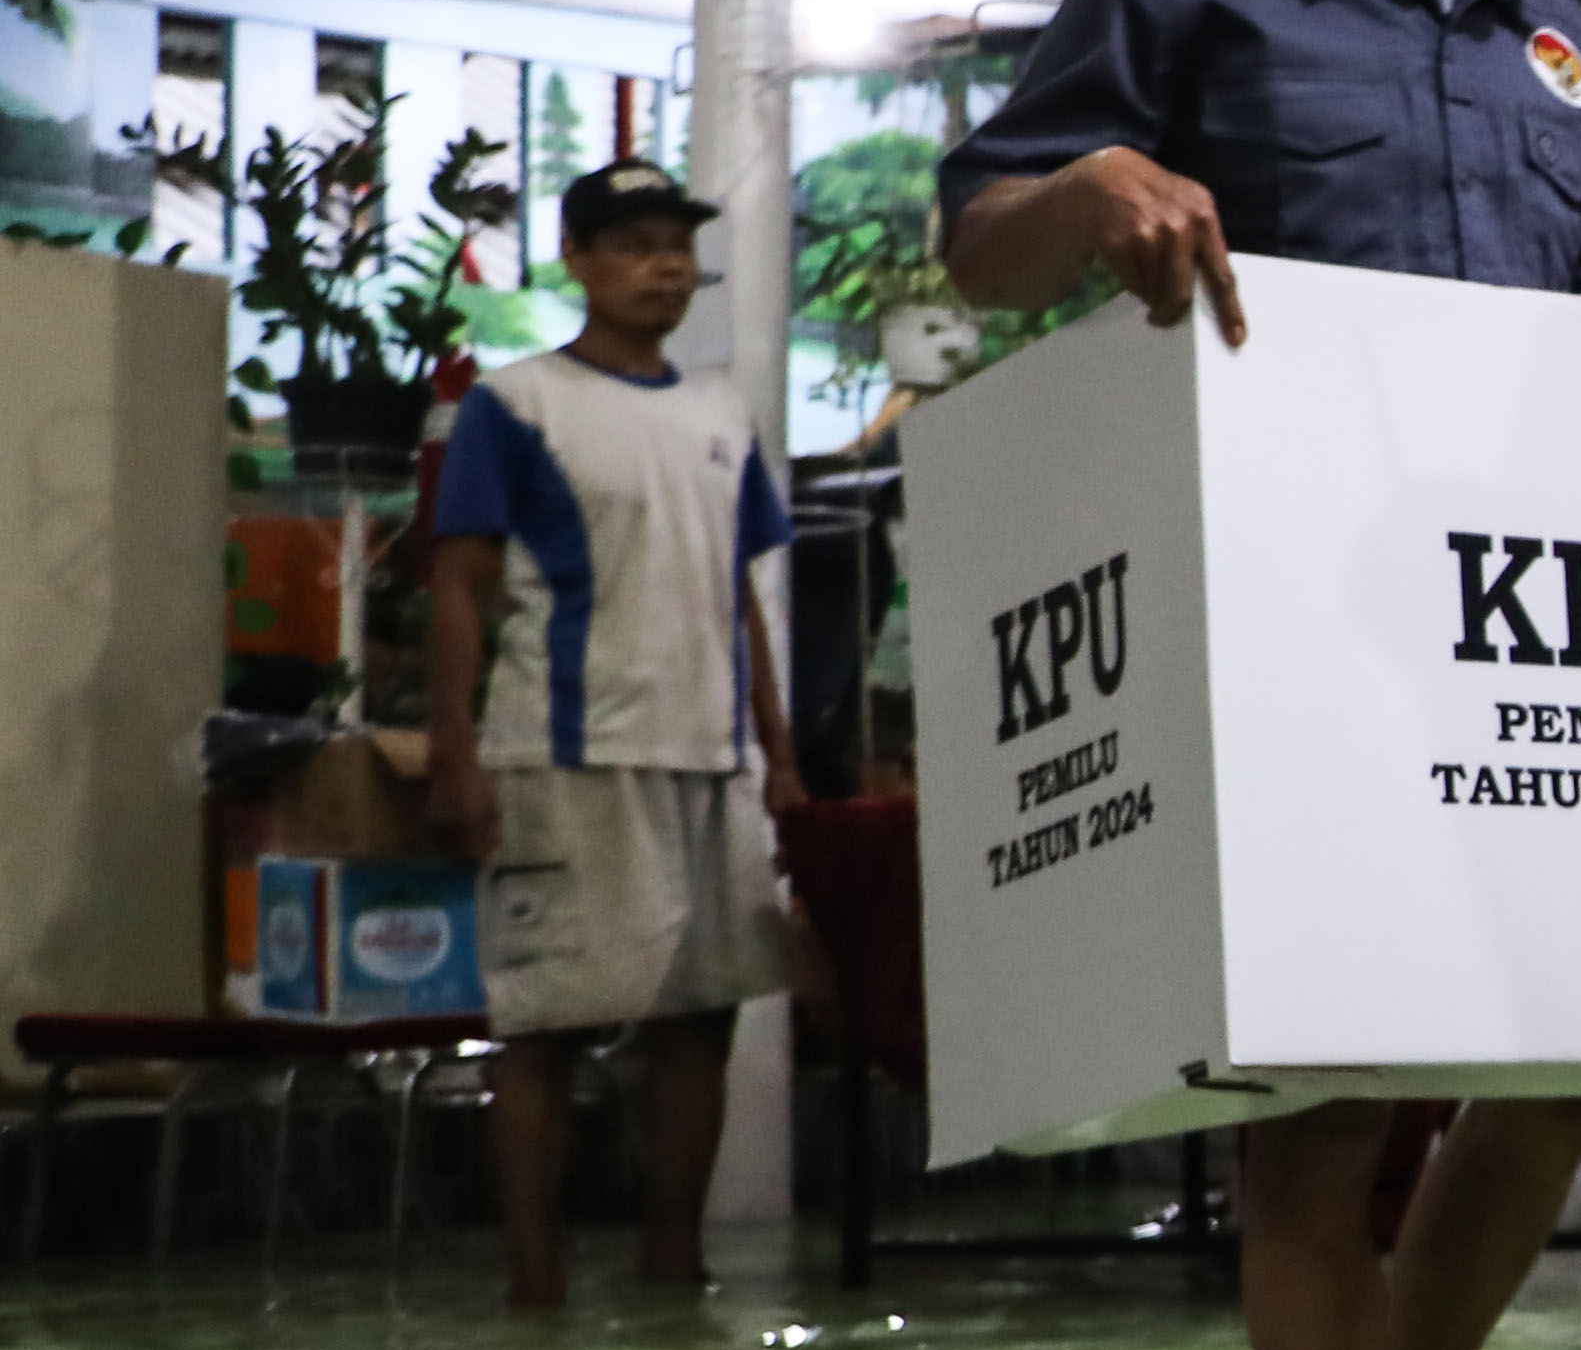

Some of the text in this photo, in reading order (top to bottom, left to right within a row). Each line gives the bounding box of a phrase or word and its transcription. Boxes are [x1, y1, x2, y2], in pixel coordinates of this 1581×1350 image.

[991, 553, 1128, 745] KPU
[1017, 730, 1118, 813] PEMILU
[988, 783, 1154, 888] TAHUN 2024
